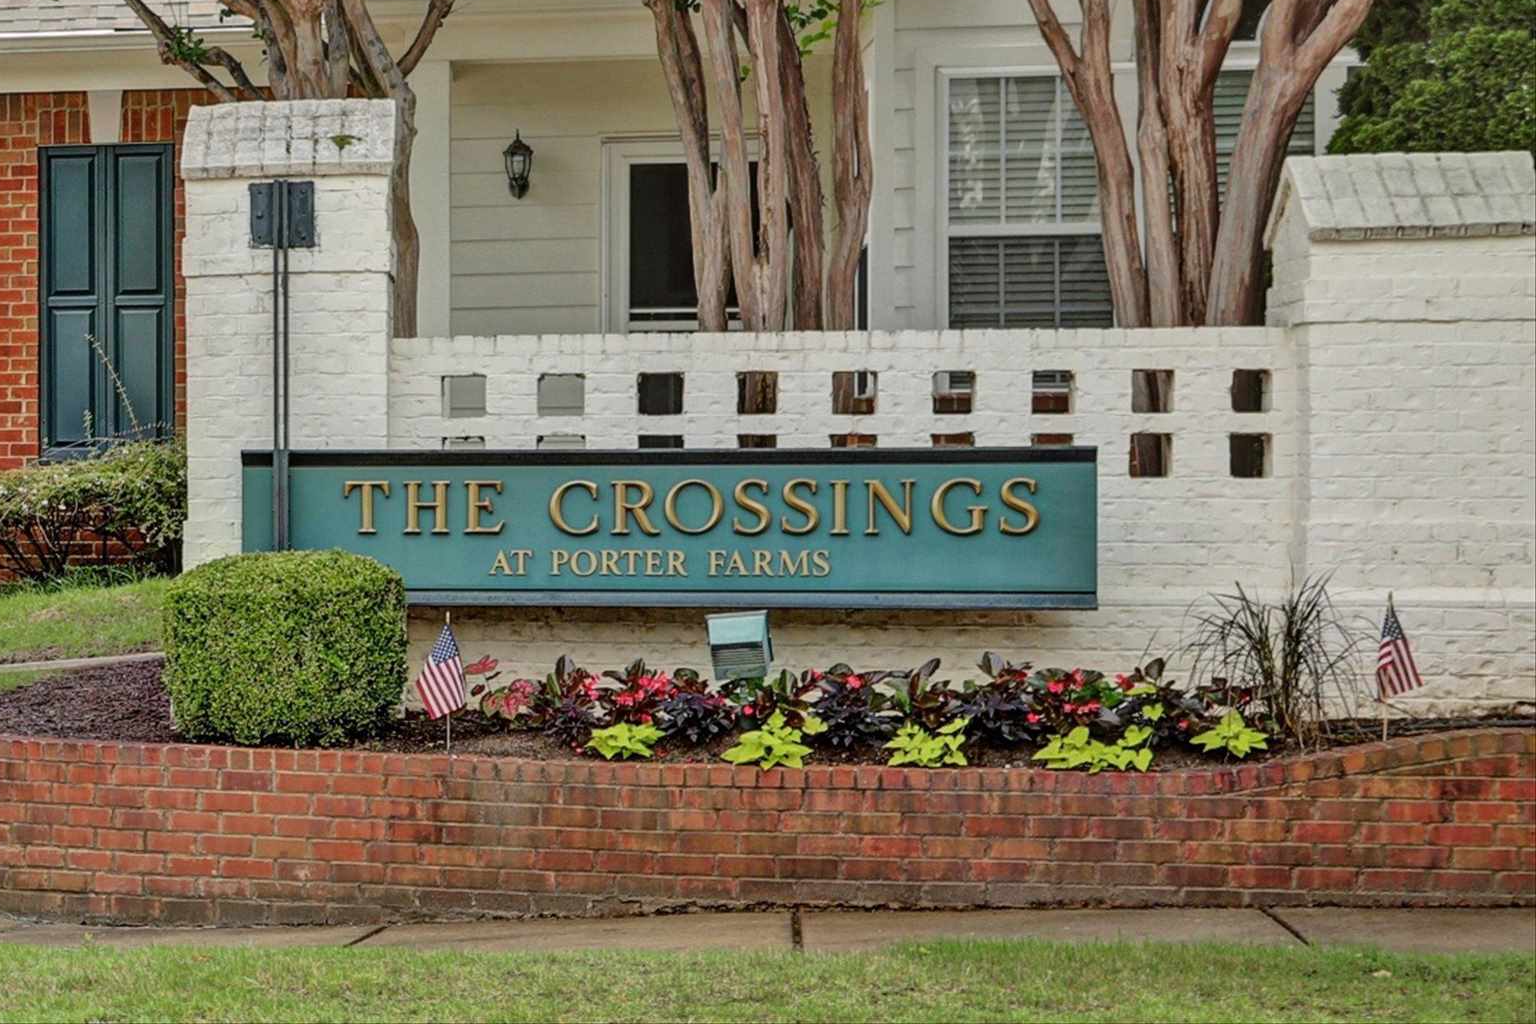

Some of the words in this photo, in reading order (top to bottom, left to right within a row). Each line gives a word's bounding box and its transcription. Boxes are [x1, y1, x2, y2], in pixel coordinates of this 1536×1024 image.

[344, 479, 506, 536] THE
[548, 477, 1042, 537] CROSSINGS
[489, 549, 532, 577] AT
[550, 549, 688, 577] PORTER
[707, 549, 832, 577] FARMS
